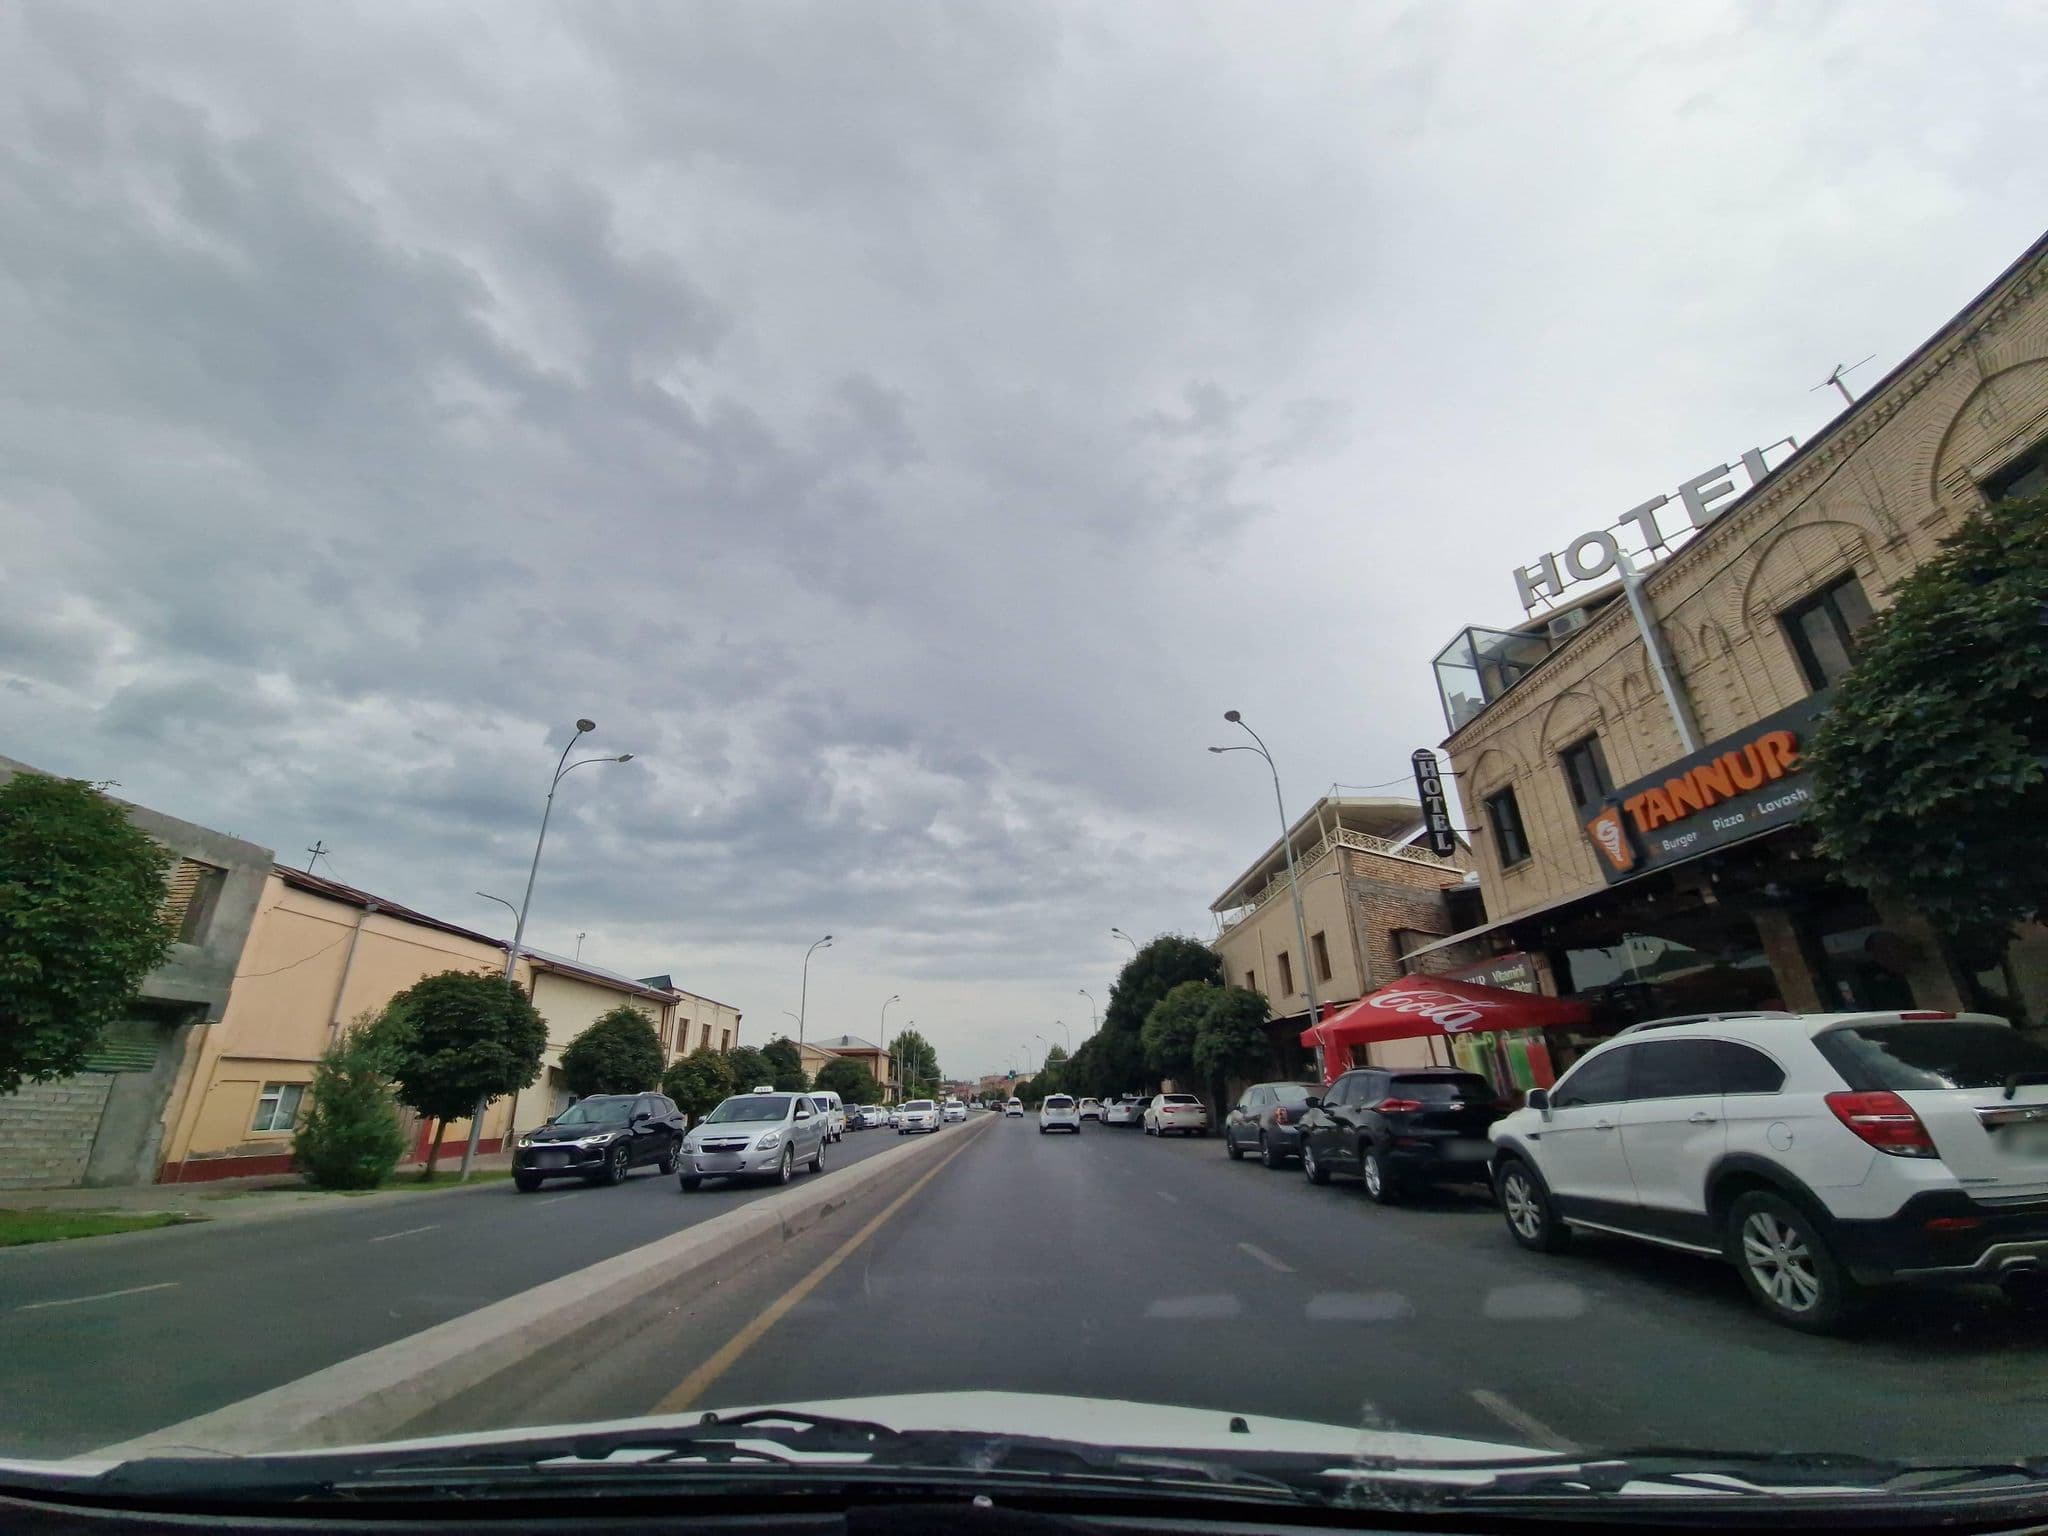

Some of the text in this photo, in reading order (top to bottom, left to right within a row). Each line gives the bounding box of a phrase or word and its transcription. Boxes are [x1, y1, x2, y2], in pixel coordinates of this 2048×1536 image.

[1418, 760, 1453, 850] HOTEL
[1624, 730, 1800, 832] TANNUR
[1662, 788, 1808, 851] Burger Pizza Lavash
